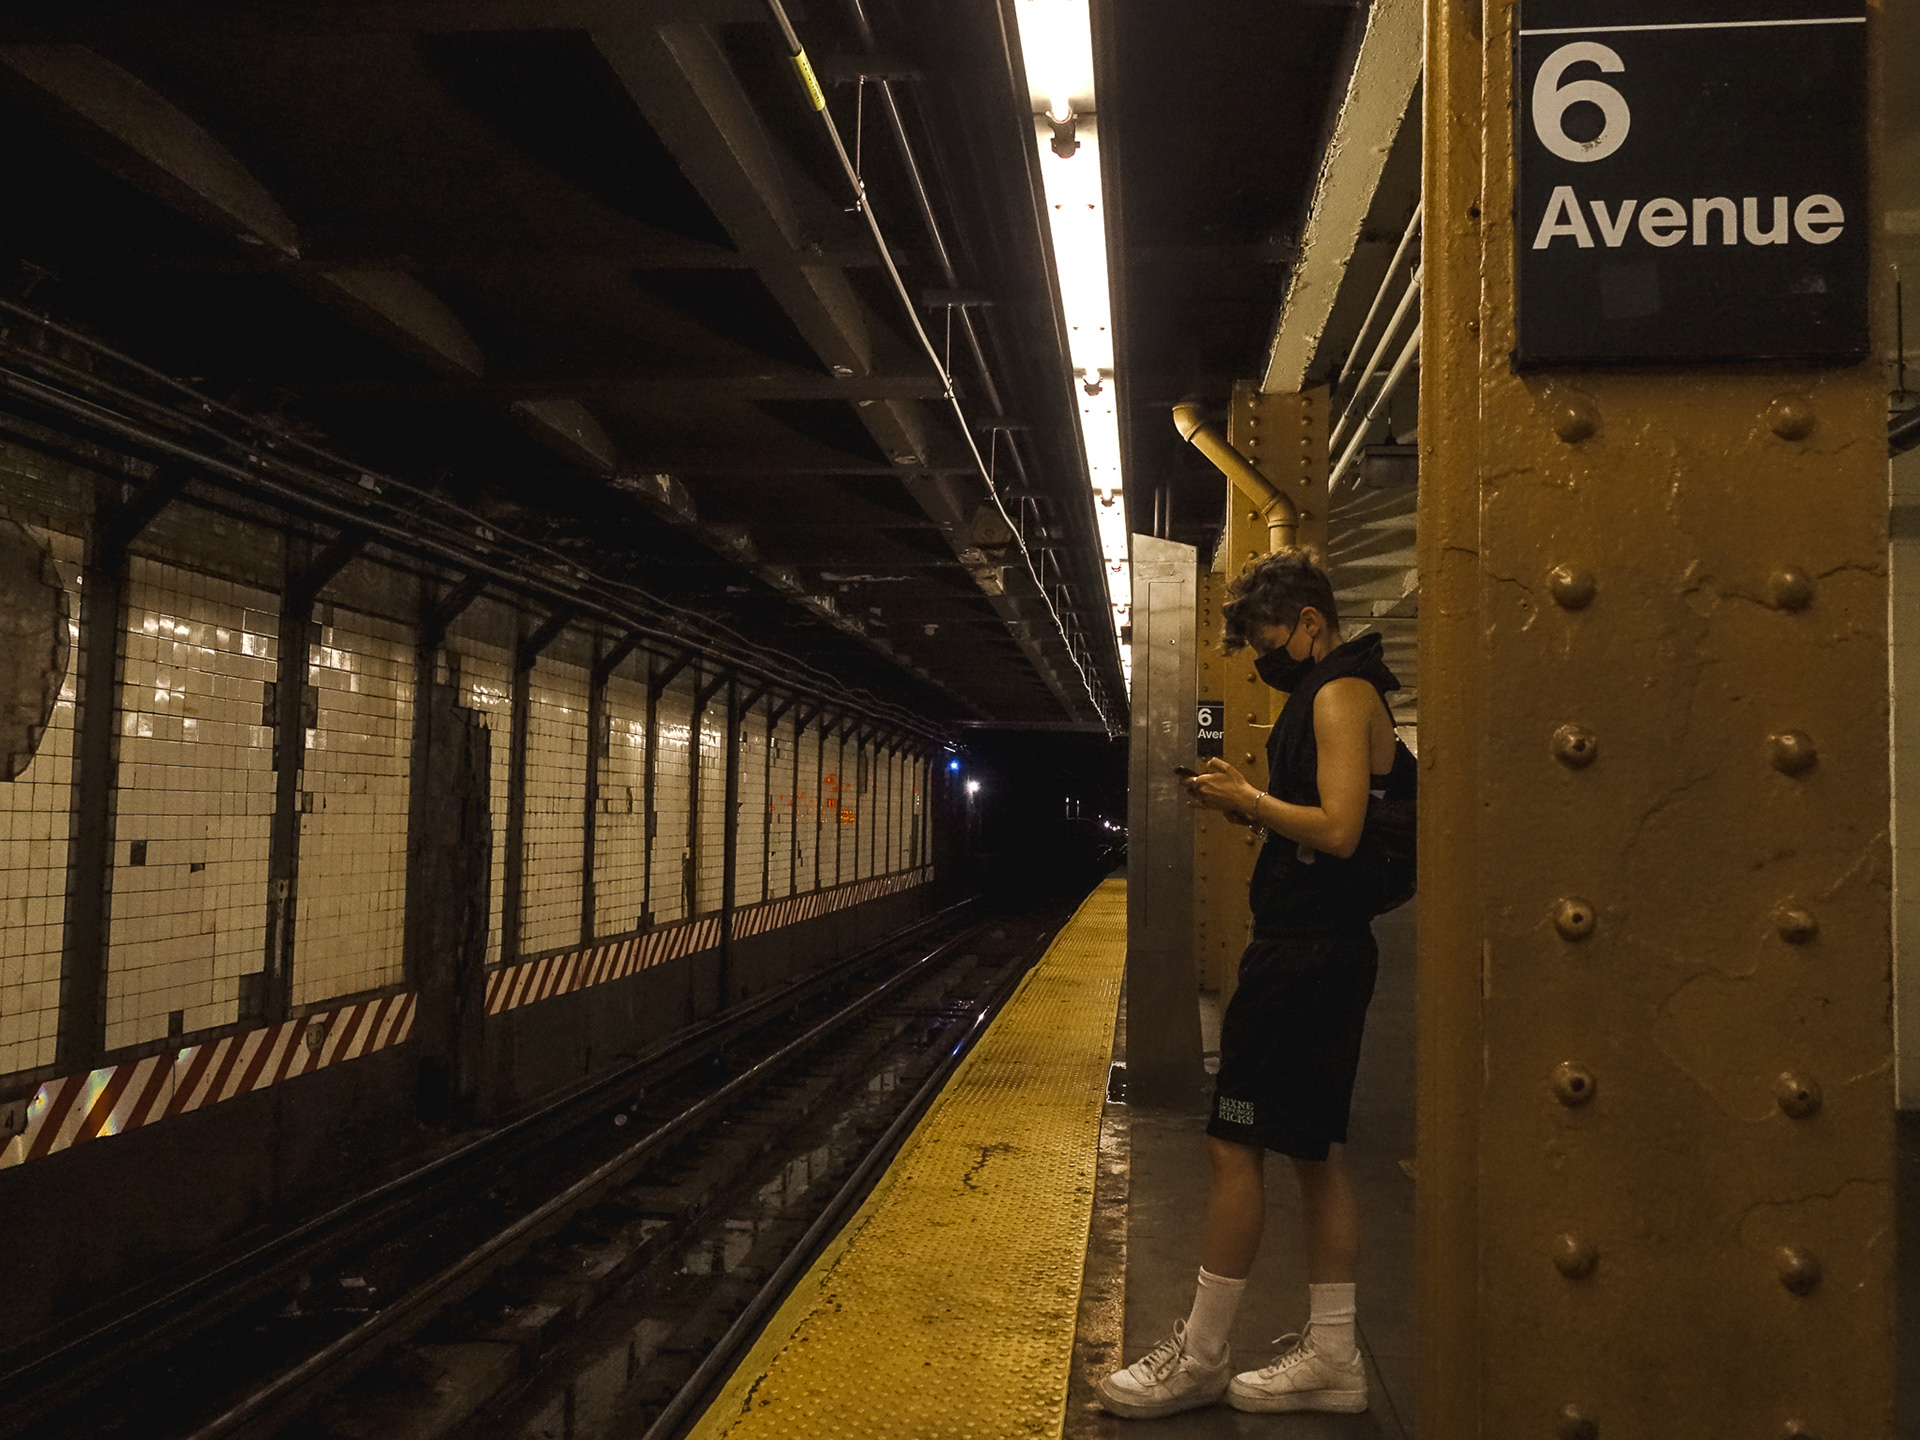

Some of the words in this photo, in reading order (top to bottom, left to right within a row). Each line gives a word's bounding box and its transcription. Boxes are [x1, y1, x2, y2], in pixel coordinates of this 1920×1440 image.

[1532, 41, 1631, 162] 6
[1532, 185, 1845, 250] Avenue
[1197, 707, 1212, 726] 6
